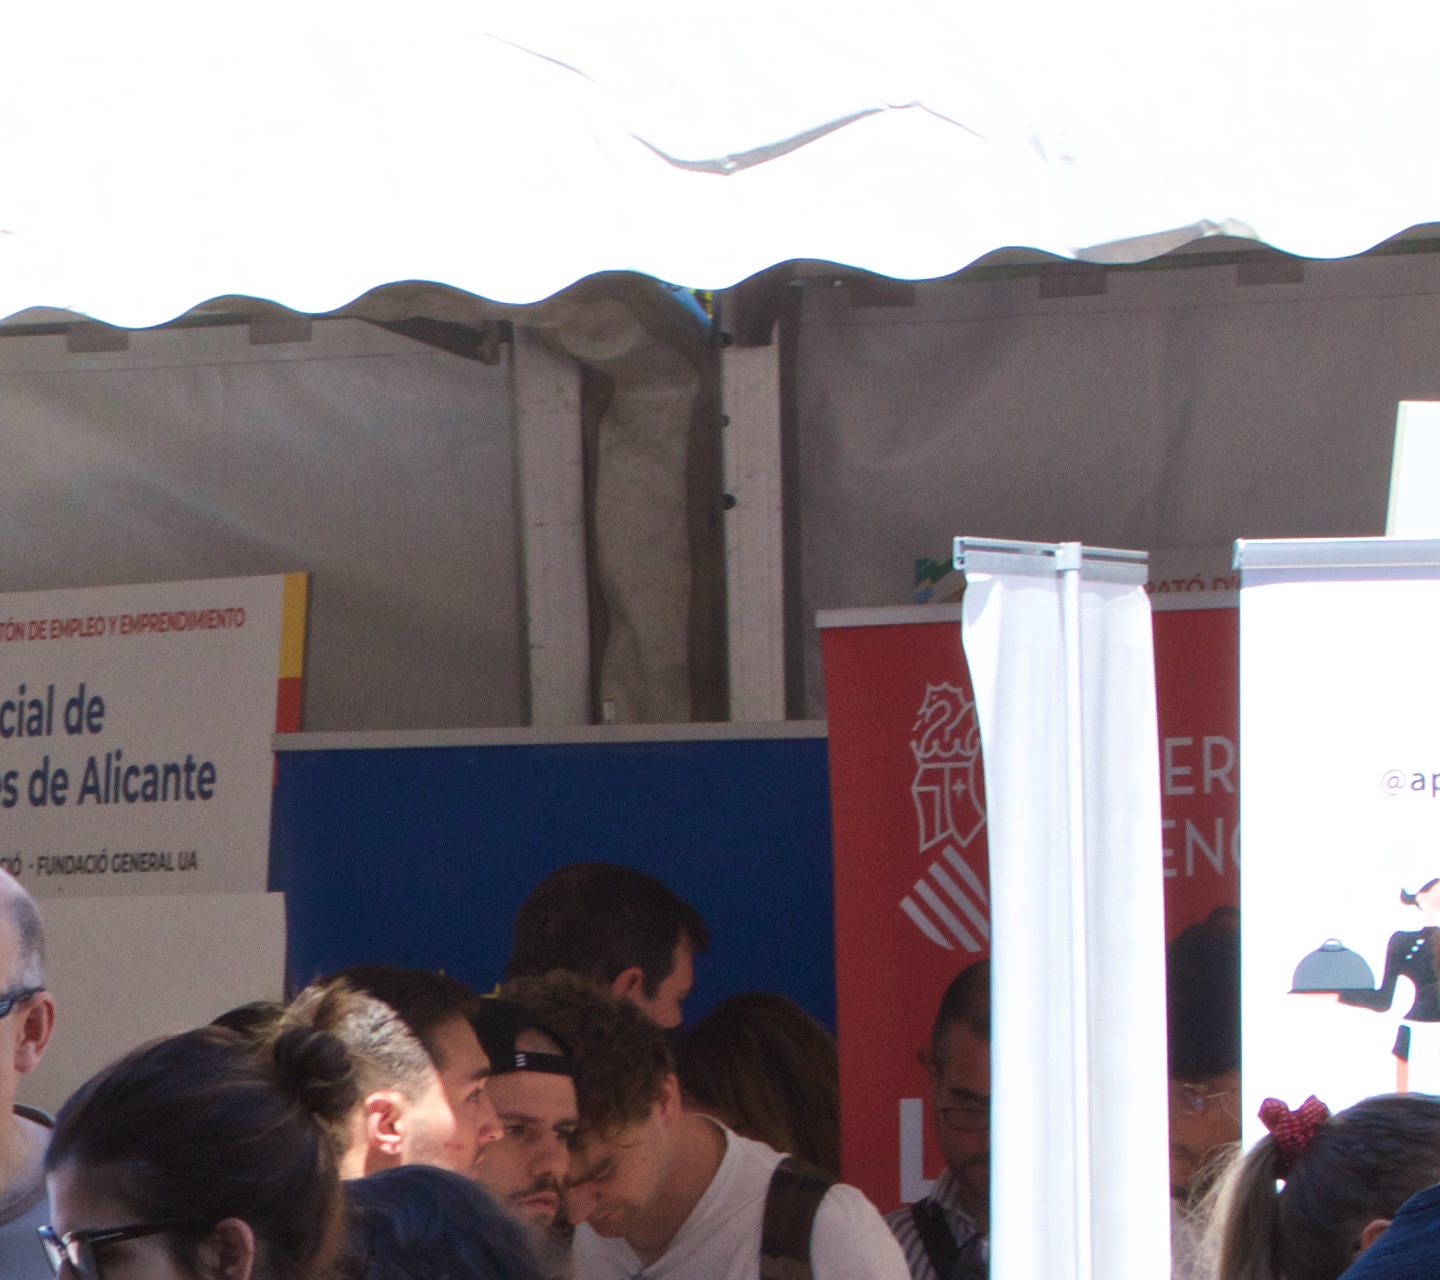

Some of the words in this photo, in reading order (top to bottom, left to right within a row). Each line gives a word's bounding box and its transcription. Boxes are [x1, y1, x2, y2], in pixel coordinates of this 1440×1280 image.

[29, 620, 47, 641] DE
[50, 616, 105, 639] EMPLEO
[107, 615, 119, 635] Y
[120, 606, 246, 635] EMPRENDIMIENTO
[63, 683, 106, 736] de
[28, 755, 69, 807] de
[79, 752, 217, 805] Alicante
[36, 849, 109, 876] FUNDACIÓ
[111, 852, 175, 874] GENERAL
[178, 850, 198, 871] UA
